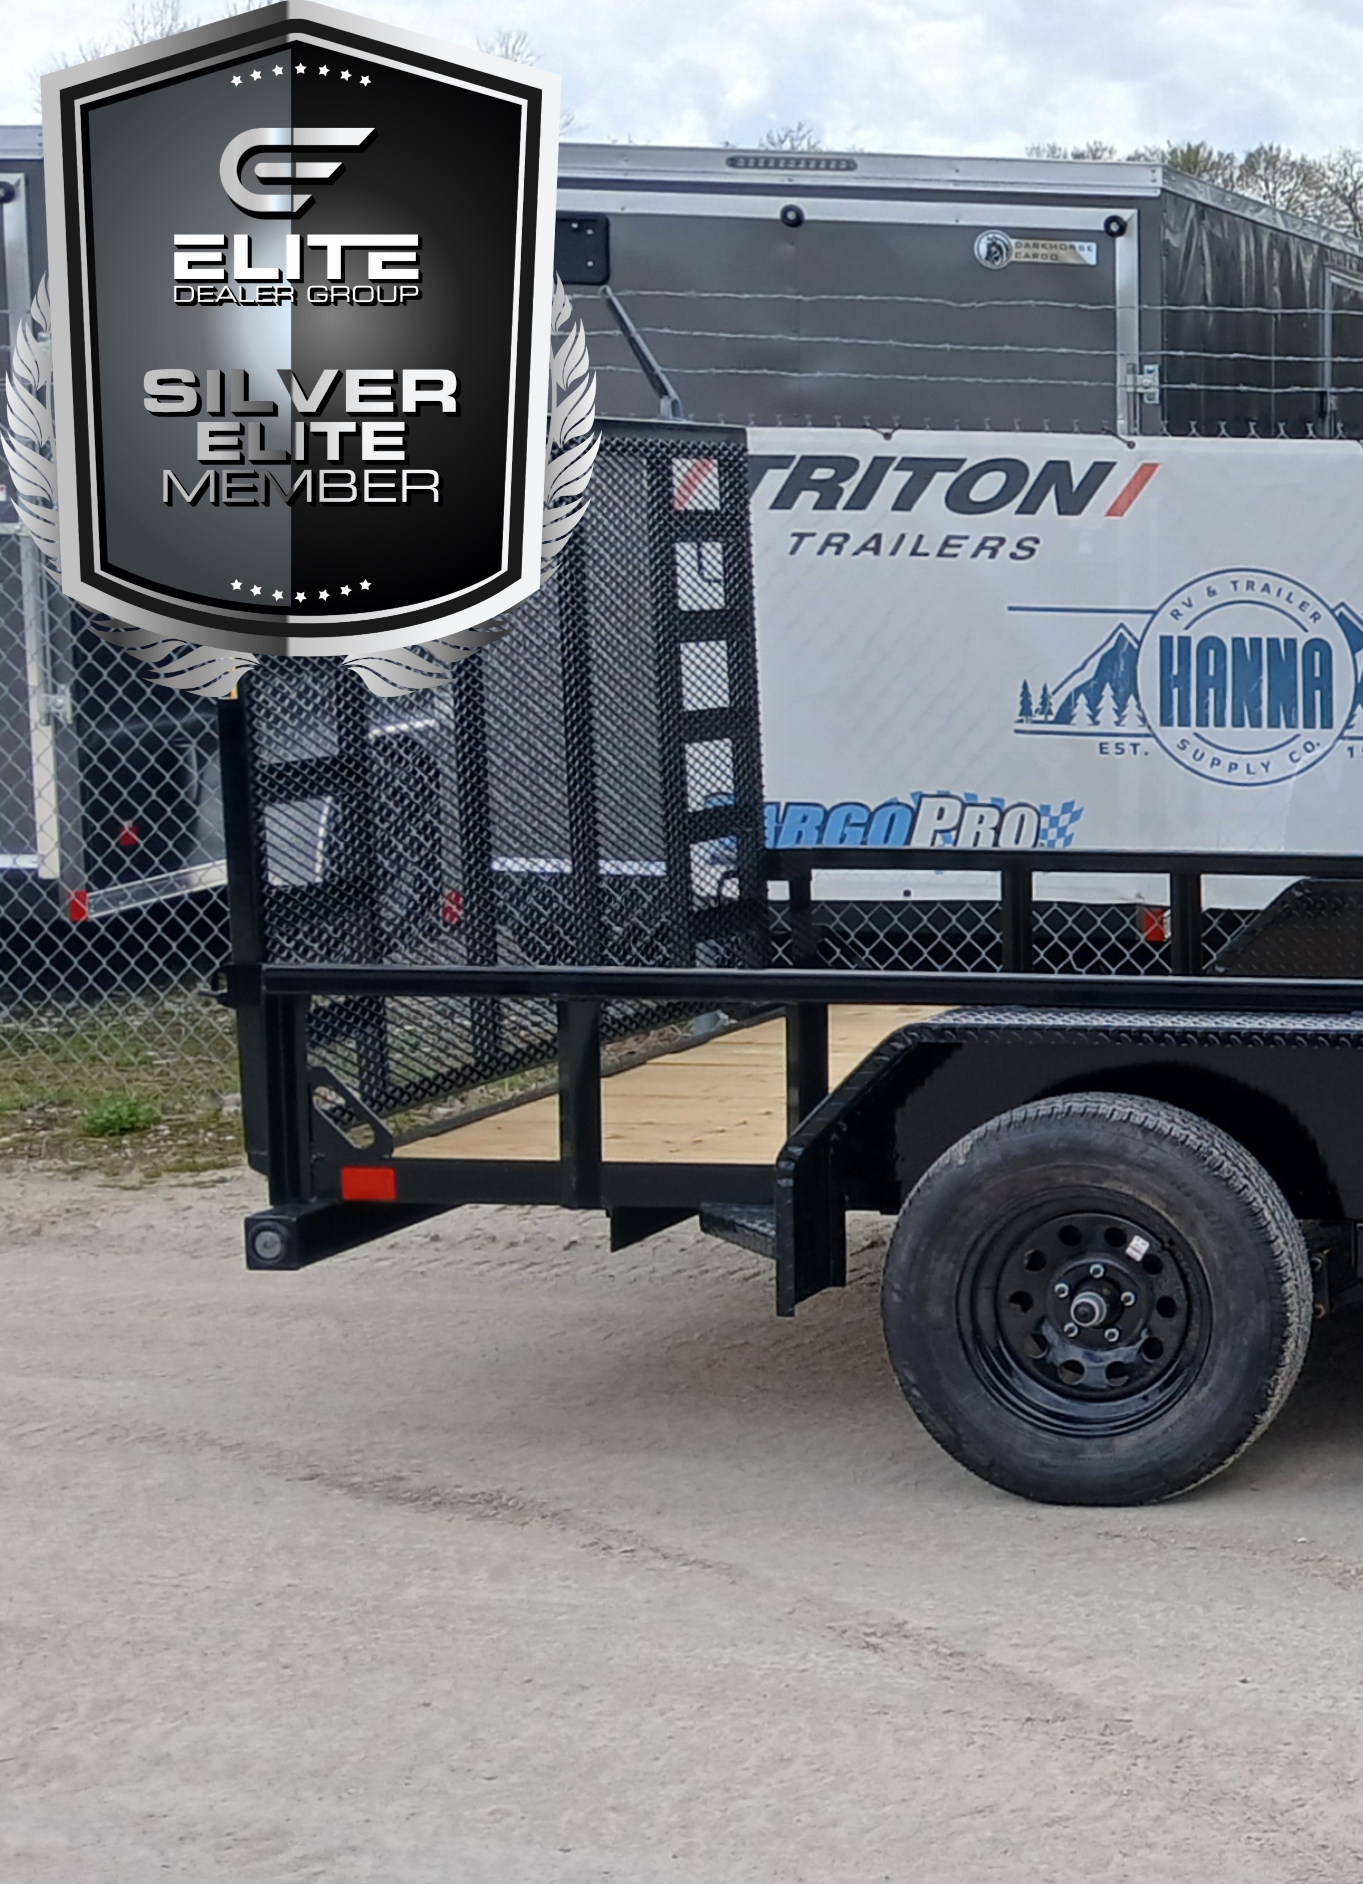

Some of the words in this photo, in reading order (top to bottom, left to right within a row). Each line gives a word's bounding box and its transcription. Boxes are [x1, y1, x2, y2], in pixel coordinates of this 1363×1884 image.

[787, 532, 1041, 561] TRAILERS
[1169, 597, 1194, 621] RV
[1206, 585, 1219, 598] &
[1230, 580, 1323, 624] TRAILER
[1159, 635, 1334, 730] HANNA
[1099, 742, 1149, 757] EST.
[1176, 738, 1272, 776] SUPPLY
[1288, 740, 1321, 764] CO.
